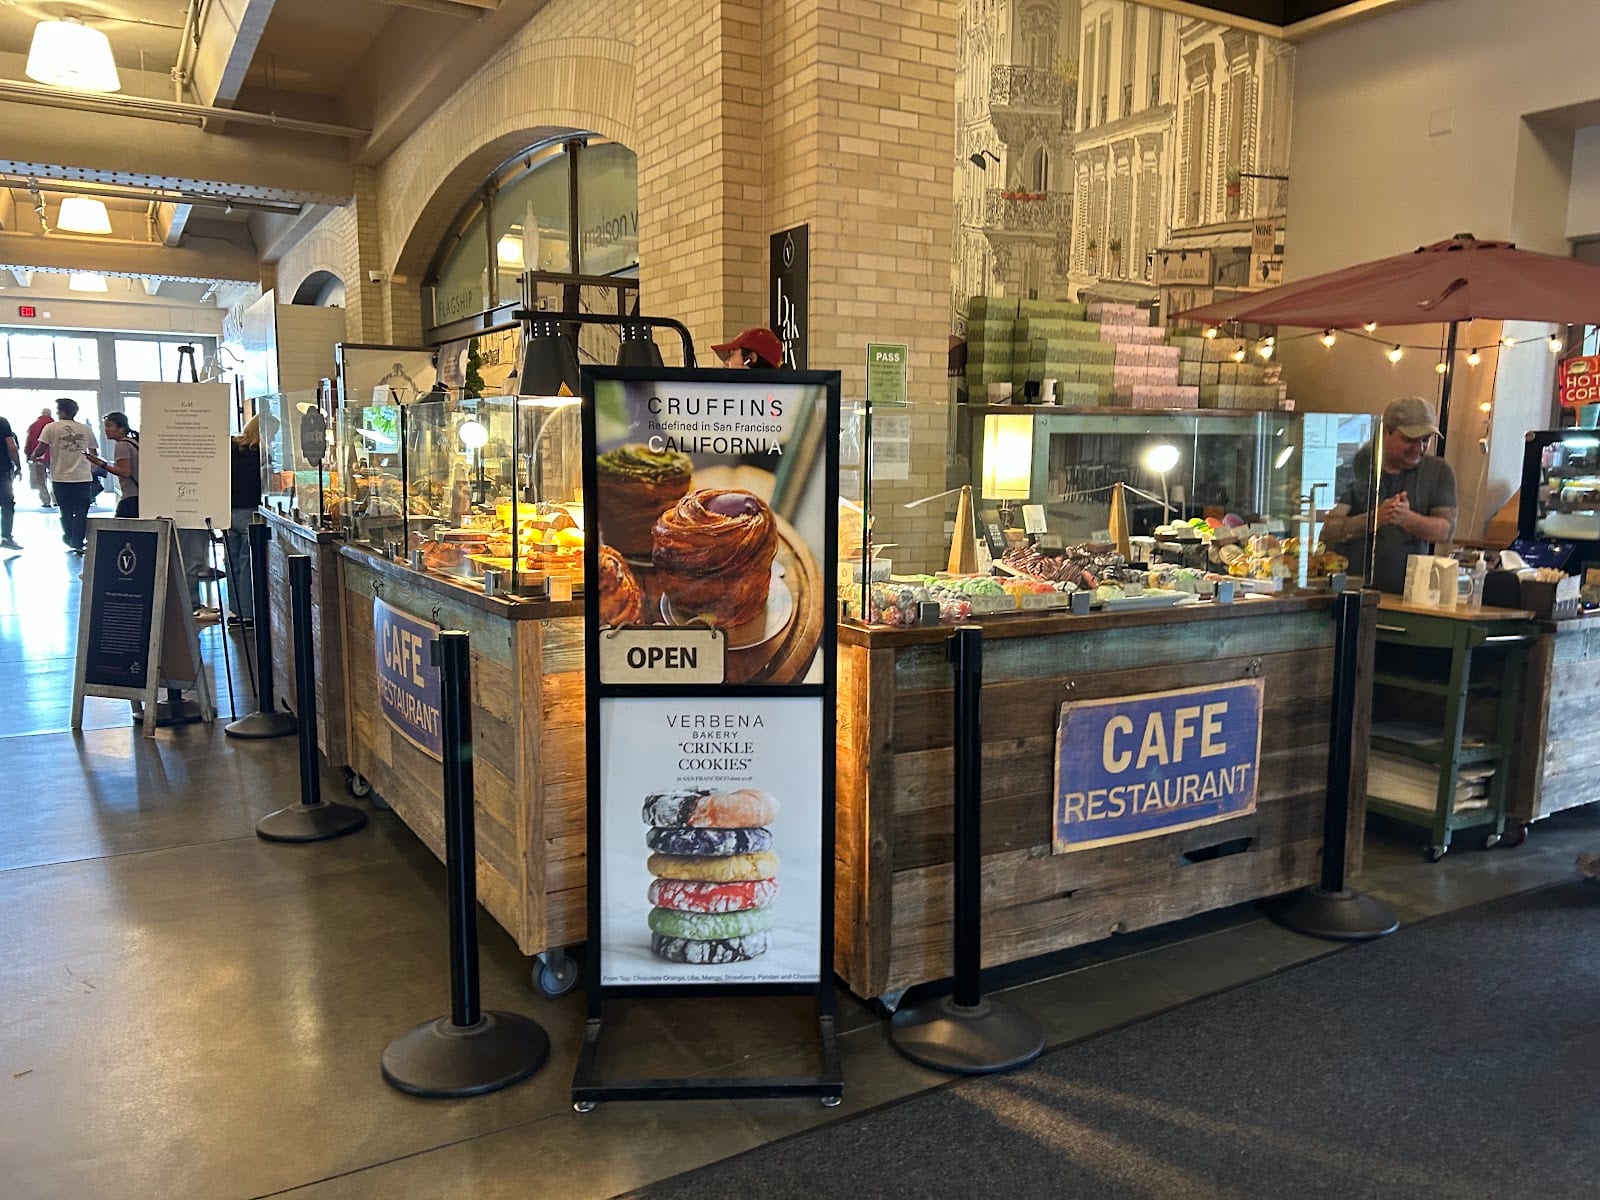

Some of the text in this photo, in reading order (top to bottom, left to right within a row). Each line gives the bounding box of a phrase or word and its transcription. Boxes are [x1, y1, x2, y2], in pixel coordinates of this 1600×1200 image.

[584, 214, 627, 252] maison
[1256, 224, 1272, 235] WINE
[438, 290, 472, 318] FLAGSHIP
[876, 352, 900, 362] PASS
[1566, 373, 1600, 389] HOT
[1566, 386, 1600, 401] COF
[648, 421, 782, 433] Redefined in San Francisco
[648, 435, 783, 456] CALIFORNIA
[122, 555, 132, 570] V
[383, 618, 425, 689] CAFE
[626, 646, 698, 669] OPEN
[379, 672, 441, 737] RESTAURANT
[666, 714, 765, 728] VERBENA
[692, 731, 739, 739] BAKERY
[1102, 701, 1229, 774] CAFE
[678, 742, 755, 753] "CRINKLE
[678, 759, 752, 770] COOKIES"
[1063, 763, 1252, 825] RESTAURANT
